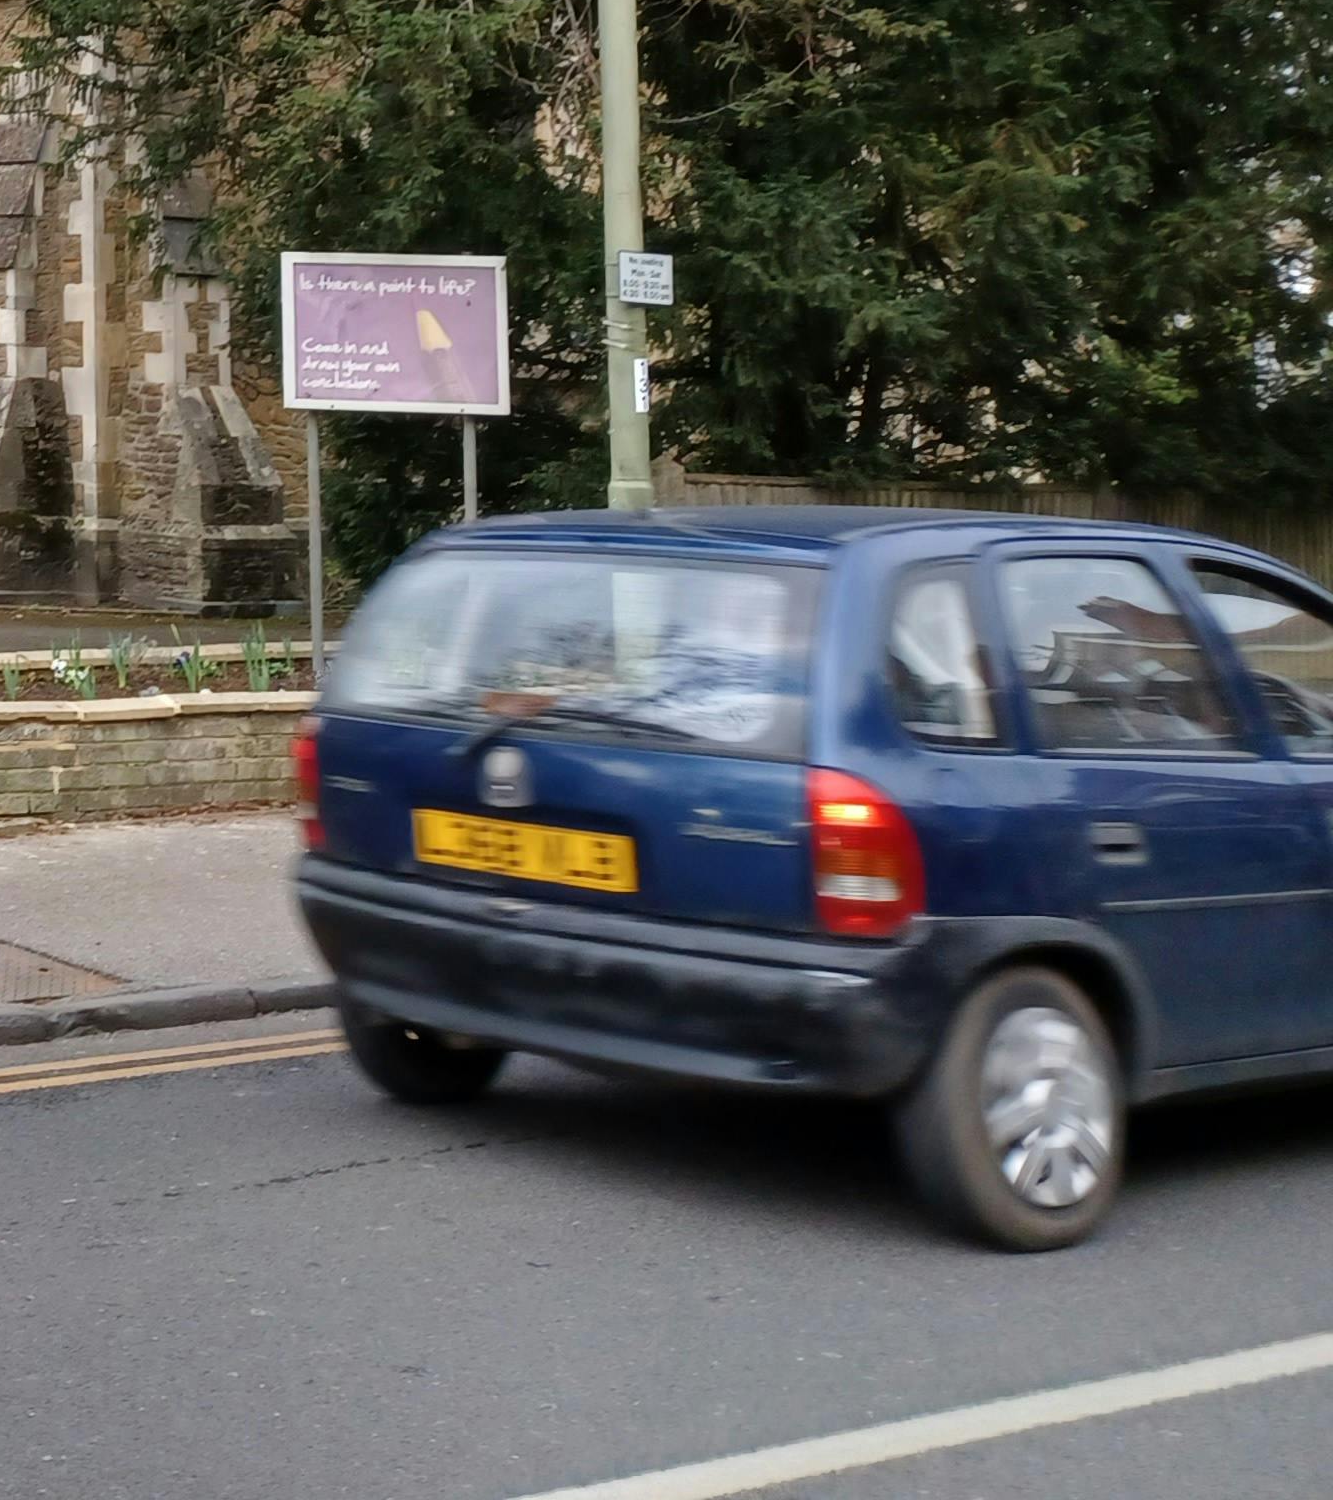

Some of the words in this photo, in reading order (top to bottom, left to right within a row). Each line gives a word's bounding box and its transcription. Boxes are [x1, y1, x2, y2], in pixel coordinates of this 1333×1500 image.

[299, 273, 314, 290] Is
[317, 274, 360, 291] there
[362, 280, 376, 291] a
[378, 277, 416, 296] point
[418, 277, 436, 294] to
[439, 275, 477, 296] life?
[301, 337, 343, 354] Come
[344, 340, 357, 354] in
[360, 340, 389, 355] and
[301, 355, 340, 371] draw
[342, 359, 373, 377] your
[374, 361, 400, 372] own
